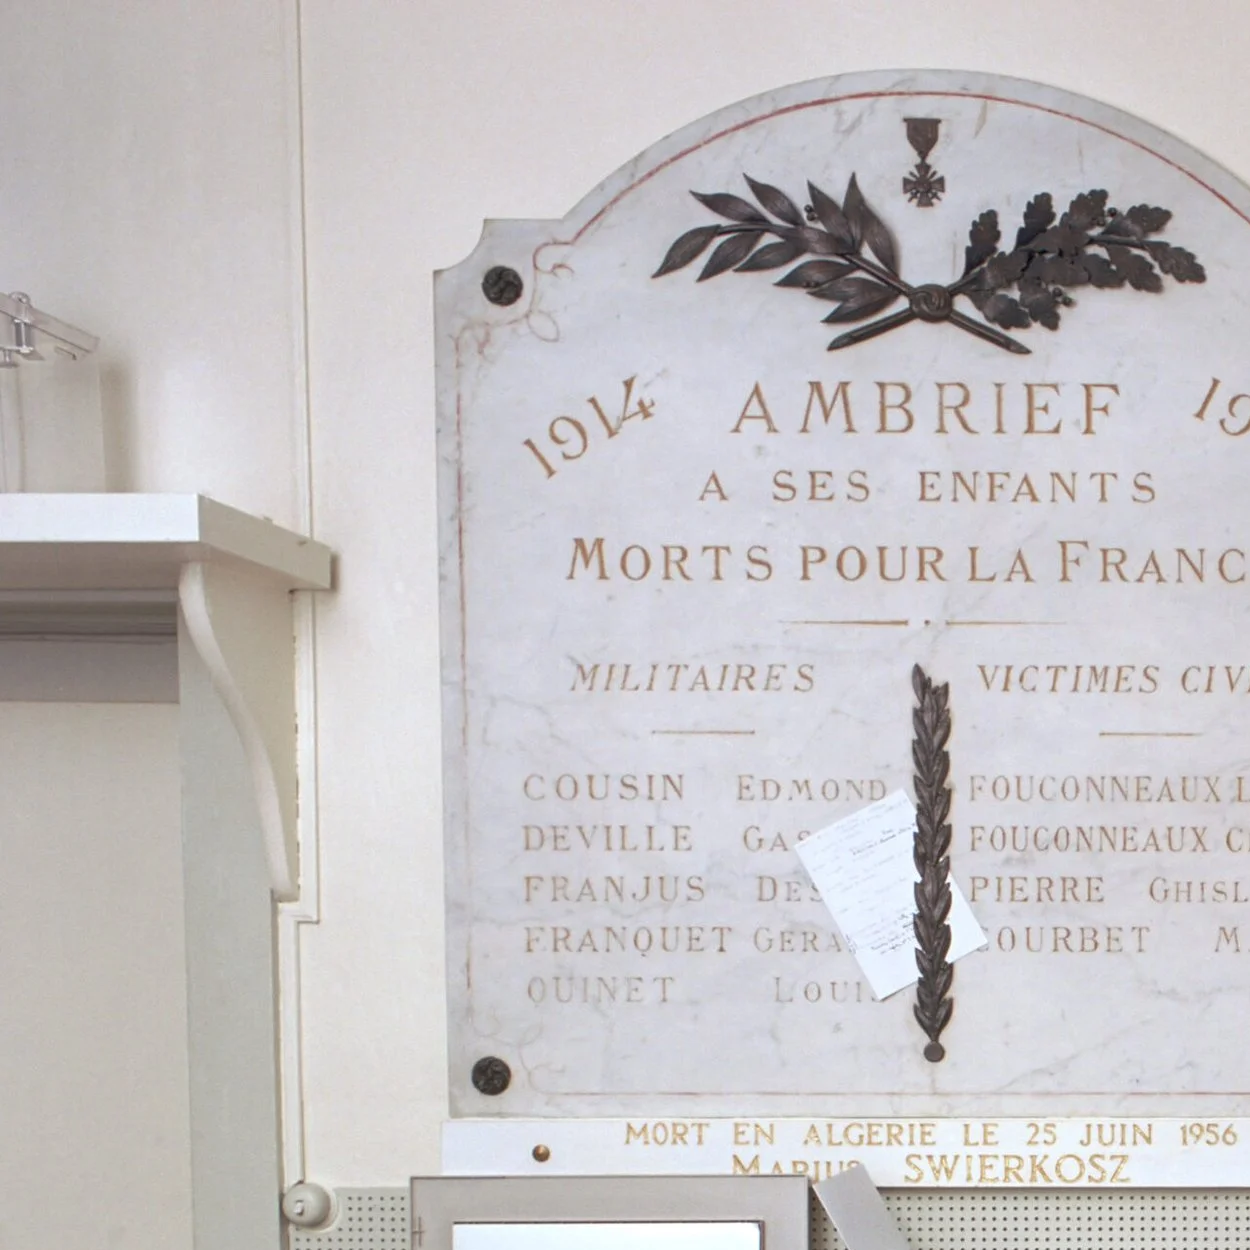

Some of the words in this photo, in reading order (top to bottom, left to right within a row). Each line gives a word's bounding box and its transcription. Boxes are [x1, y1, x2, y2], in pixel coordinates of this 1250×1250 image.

[730, 380, 1121, 436] AMBRIEF
[522, 375, 657, 480] 1914
[698, 470, 729, 502] A
[772, 469, 871, 502] SES
[918, 470, 1157, 503] ENFANTS
[565, 536, 775, 582] MORTS
[799, 544, 949, 583] POUR
[967, 546, 1037, 584] LA
[569, 663, 816, 693] MILITAIRES
[976, 664, 1161, 694] VICTIMES
[522, 774, 685, 802] COUSIN
[737, 775, 888, 803] EDMOND
[968, 775, 1222, 803] FOUCONNEAUX
[522, 824, 693, 852] DEVILLE
[969, 825, 1212, 853] FOUCONNEAUX
[523, 875, 706, 903] FRANJUS
[969, 876, 1105, 904] PIERRE
[524, 926, 733, 957] FRANQUET
[753, 927, 842, 953] GERA
[773, 976, 876, 1003] LOUI
[624, 1122, 710, 1147] MORT
[733, 1122, 775, 1146] EN
[803, 1122, 936, 1147] ALGERIE
[963, 1123, 1000, 1147] LE
[1026, 1123, 1057, 1147] 25
[1079, 1122, 1154, 1147] JUIN
[1179, 1122, 1239, 1147] 1956
[904, 1153, 1132, 1185] SWIERKOSZ
